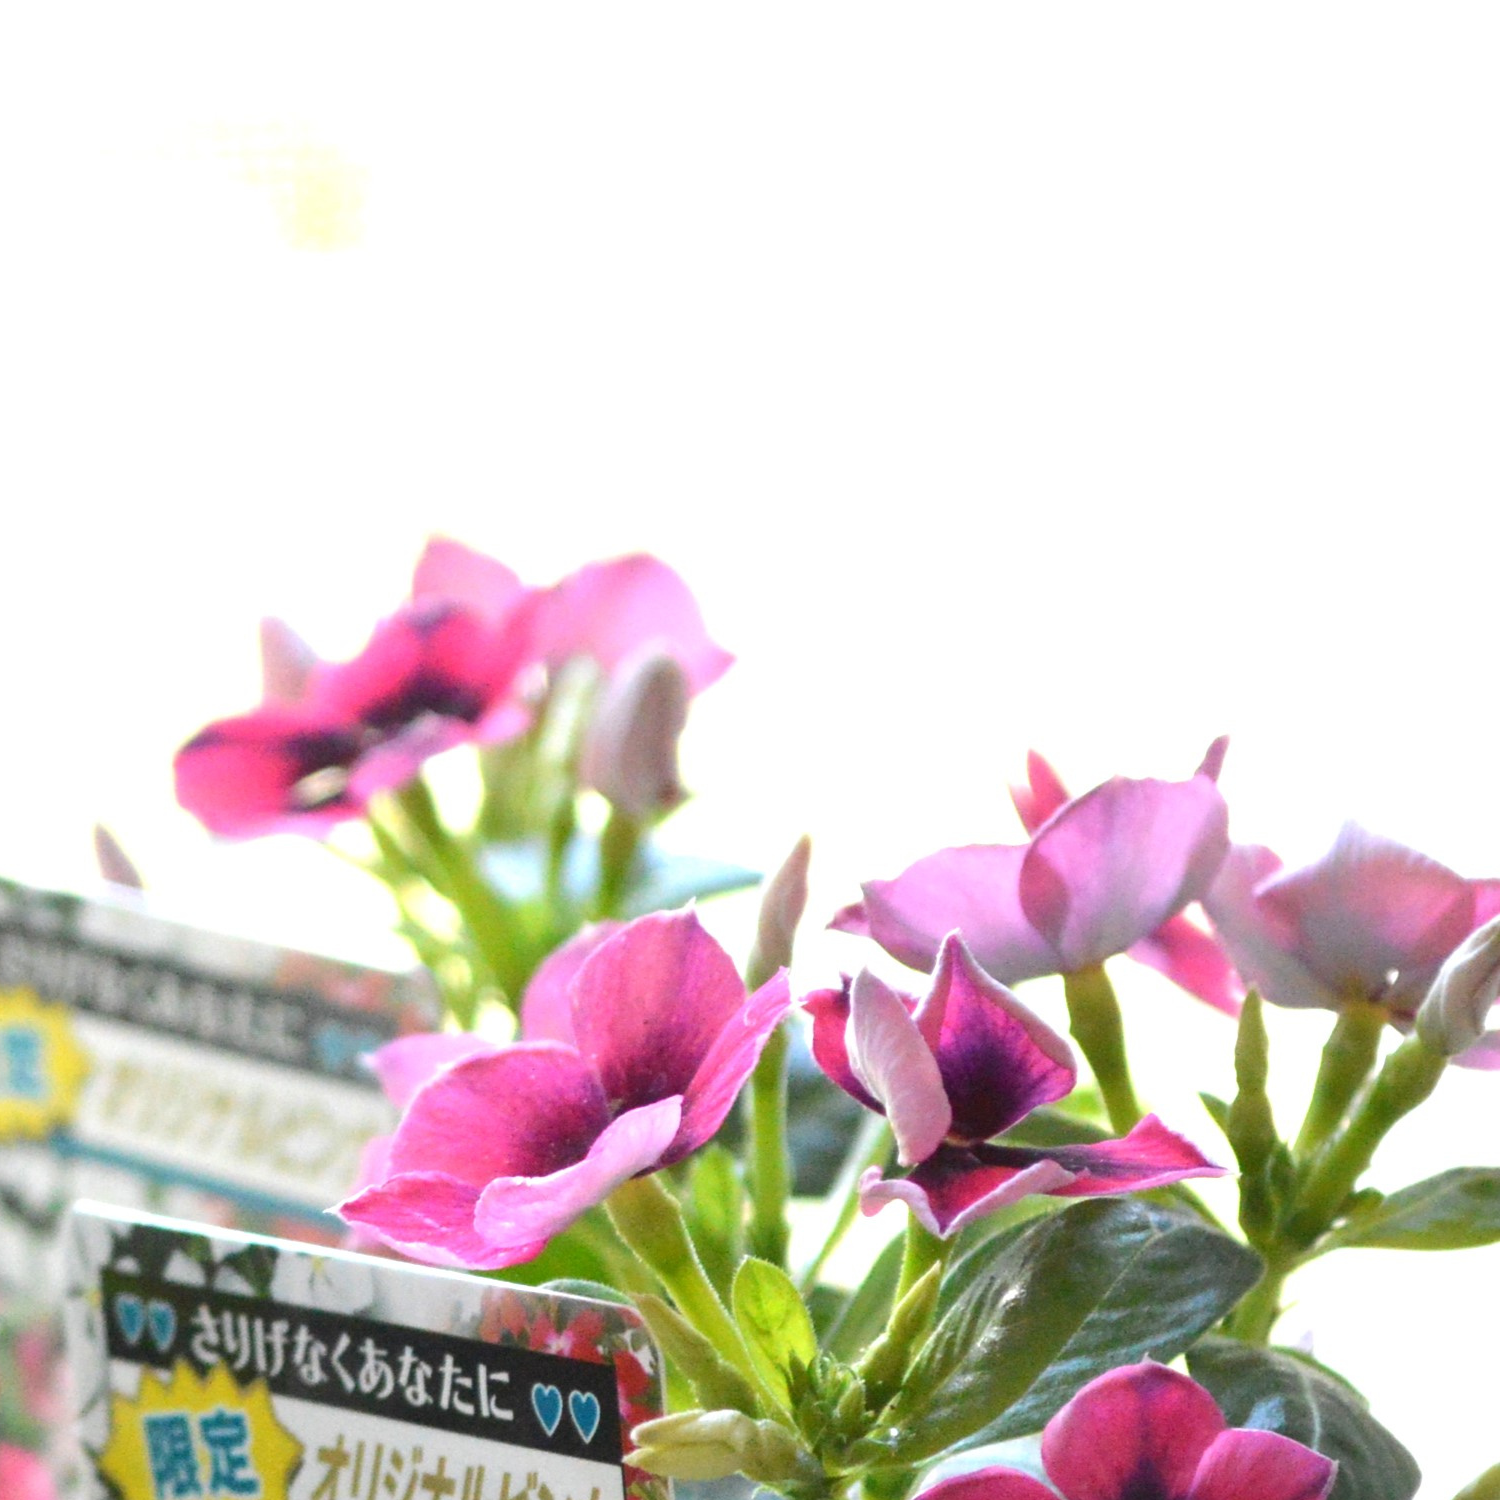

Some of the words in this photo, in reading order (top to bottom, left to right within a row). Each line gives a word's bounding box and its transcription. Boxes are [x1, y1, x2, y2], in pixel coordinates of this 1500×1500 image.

[191, 1304, 514, 1421] さりげなくあなたに
[143, 1408, 261, 1497] 限定
